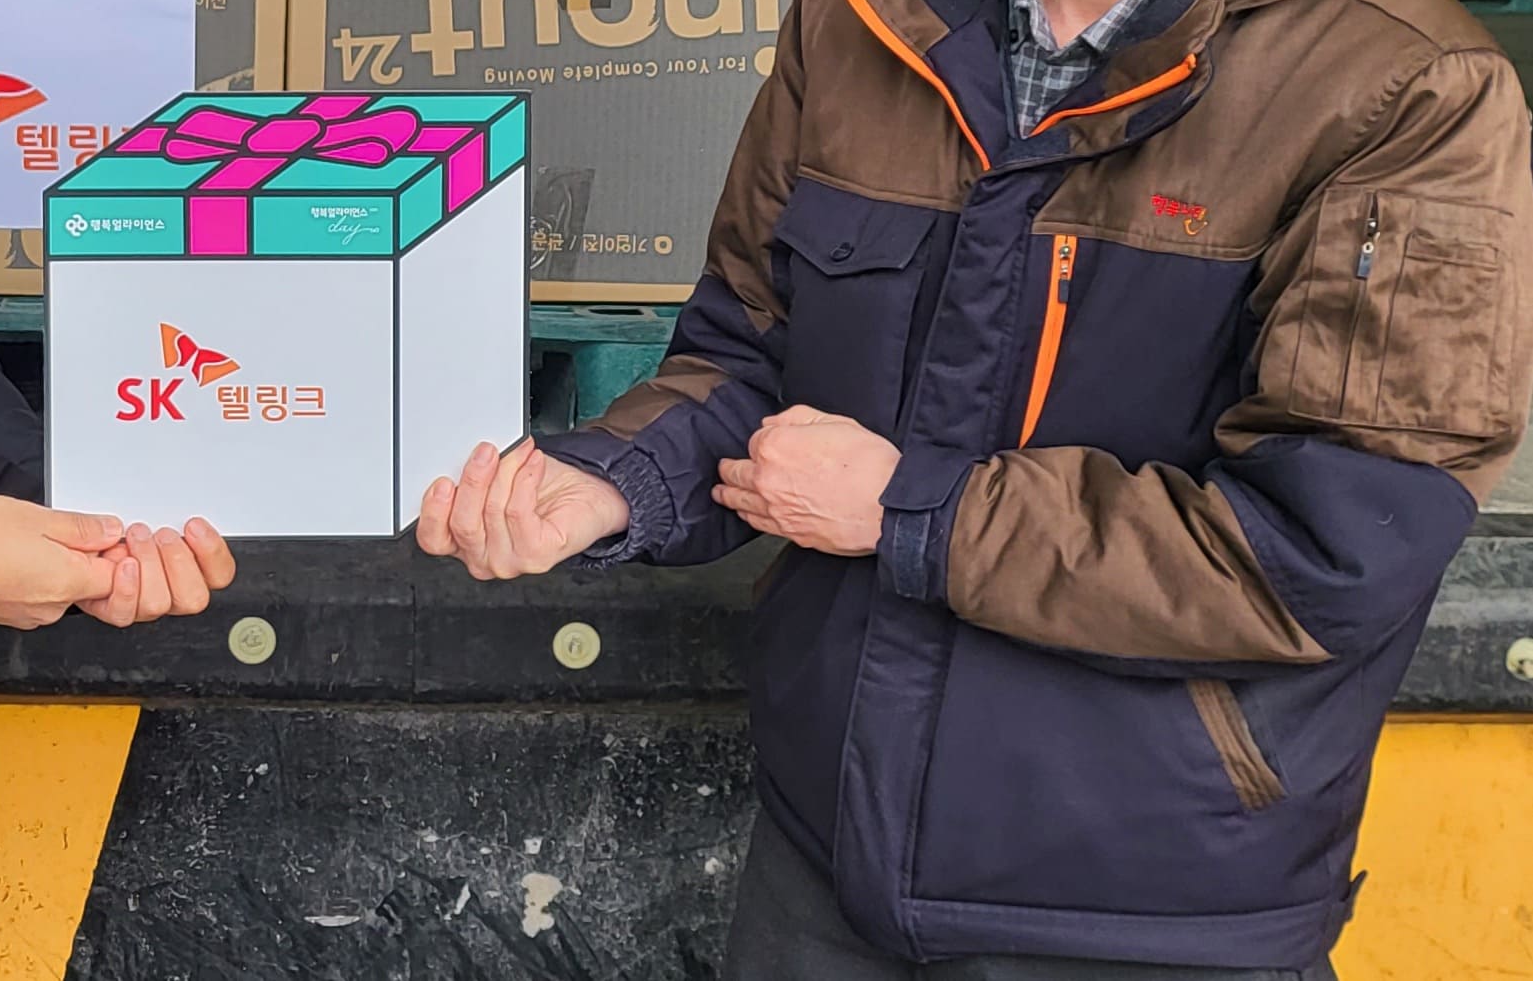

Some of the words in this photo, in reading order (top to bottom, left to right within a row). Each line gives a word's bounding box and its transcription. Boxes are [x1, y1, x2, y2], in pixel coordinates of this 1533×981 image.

[332, 28, 403, 86] 24
[666, 58, 710, 74] Your
[717, 55, 747, 72] For
[484, 66, 555, 85] Moving
[563, 60, 658, 80] Complete
[15, 125, 133, 170] 텔링
[90, 217, 166, 232] 행복얼라이언스
[327, 215, 380, 246] day
[582, 233, 648, 253] 기업이전
[115, 378, 186, 422] SK
[216, 385, 327, 422] 텔링크
